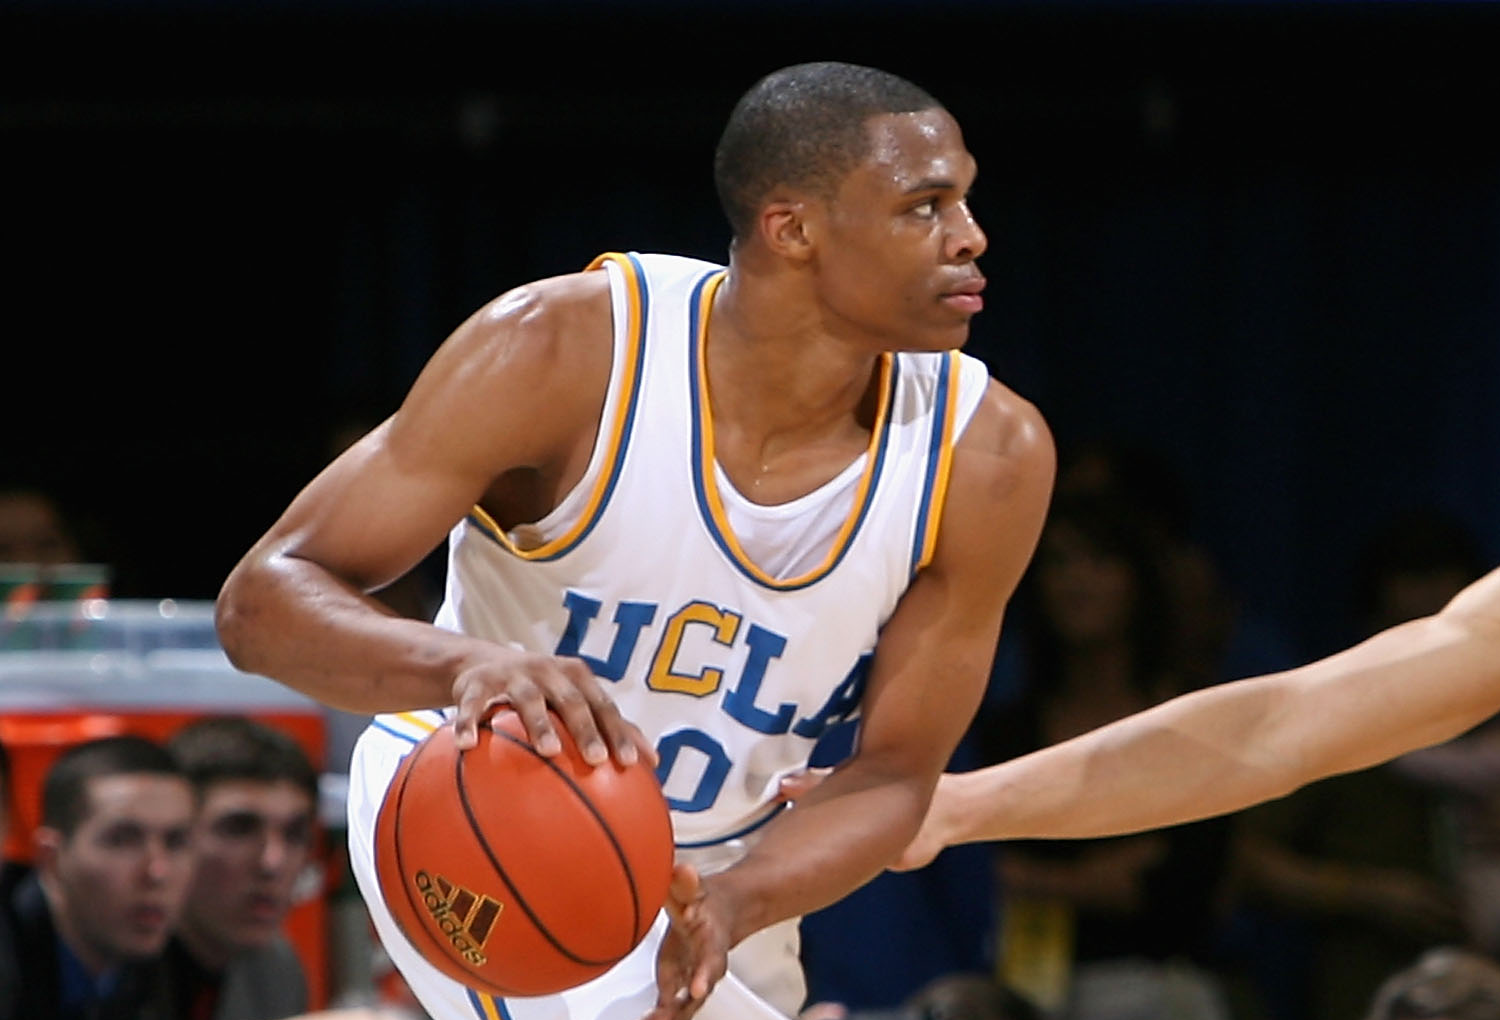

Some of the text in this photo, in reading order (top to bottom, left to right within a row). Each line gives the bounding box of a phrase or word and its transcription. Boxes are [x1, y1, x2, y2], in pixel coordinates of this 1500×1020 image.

[555, 590, 875, 739] UCLA
[655, 728, 733, 813] 0
[414, 868, 487, 966] adidas
